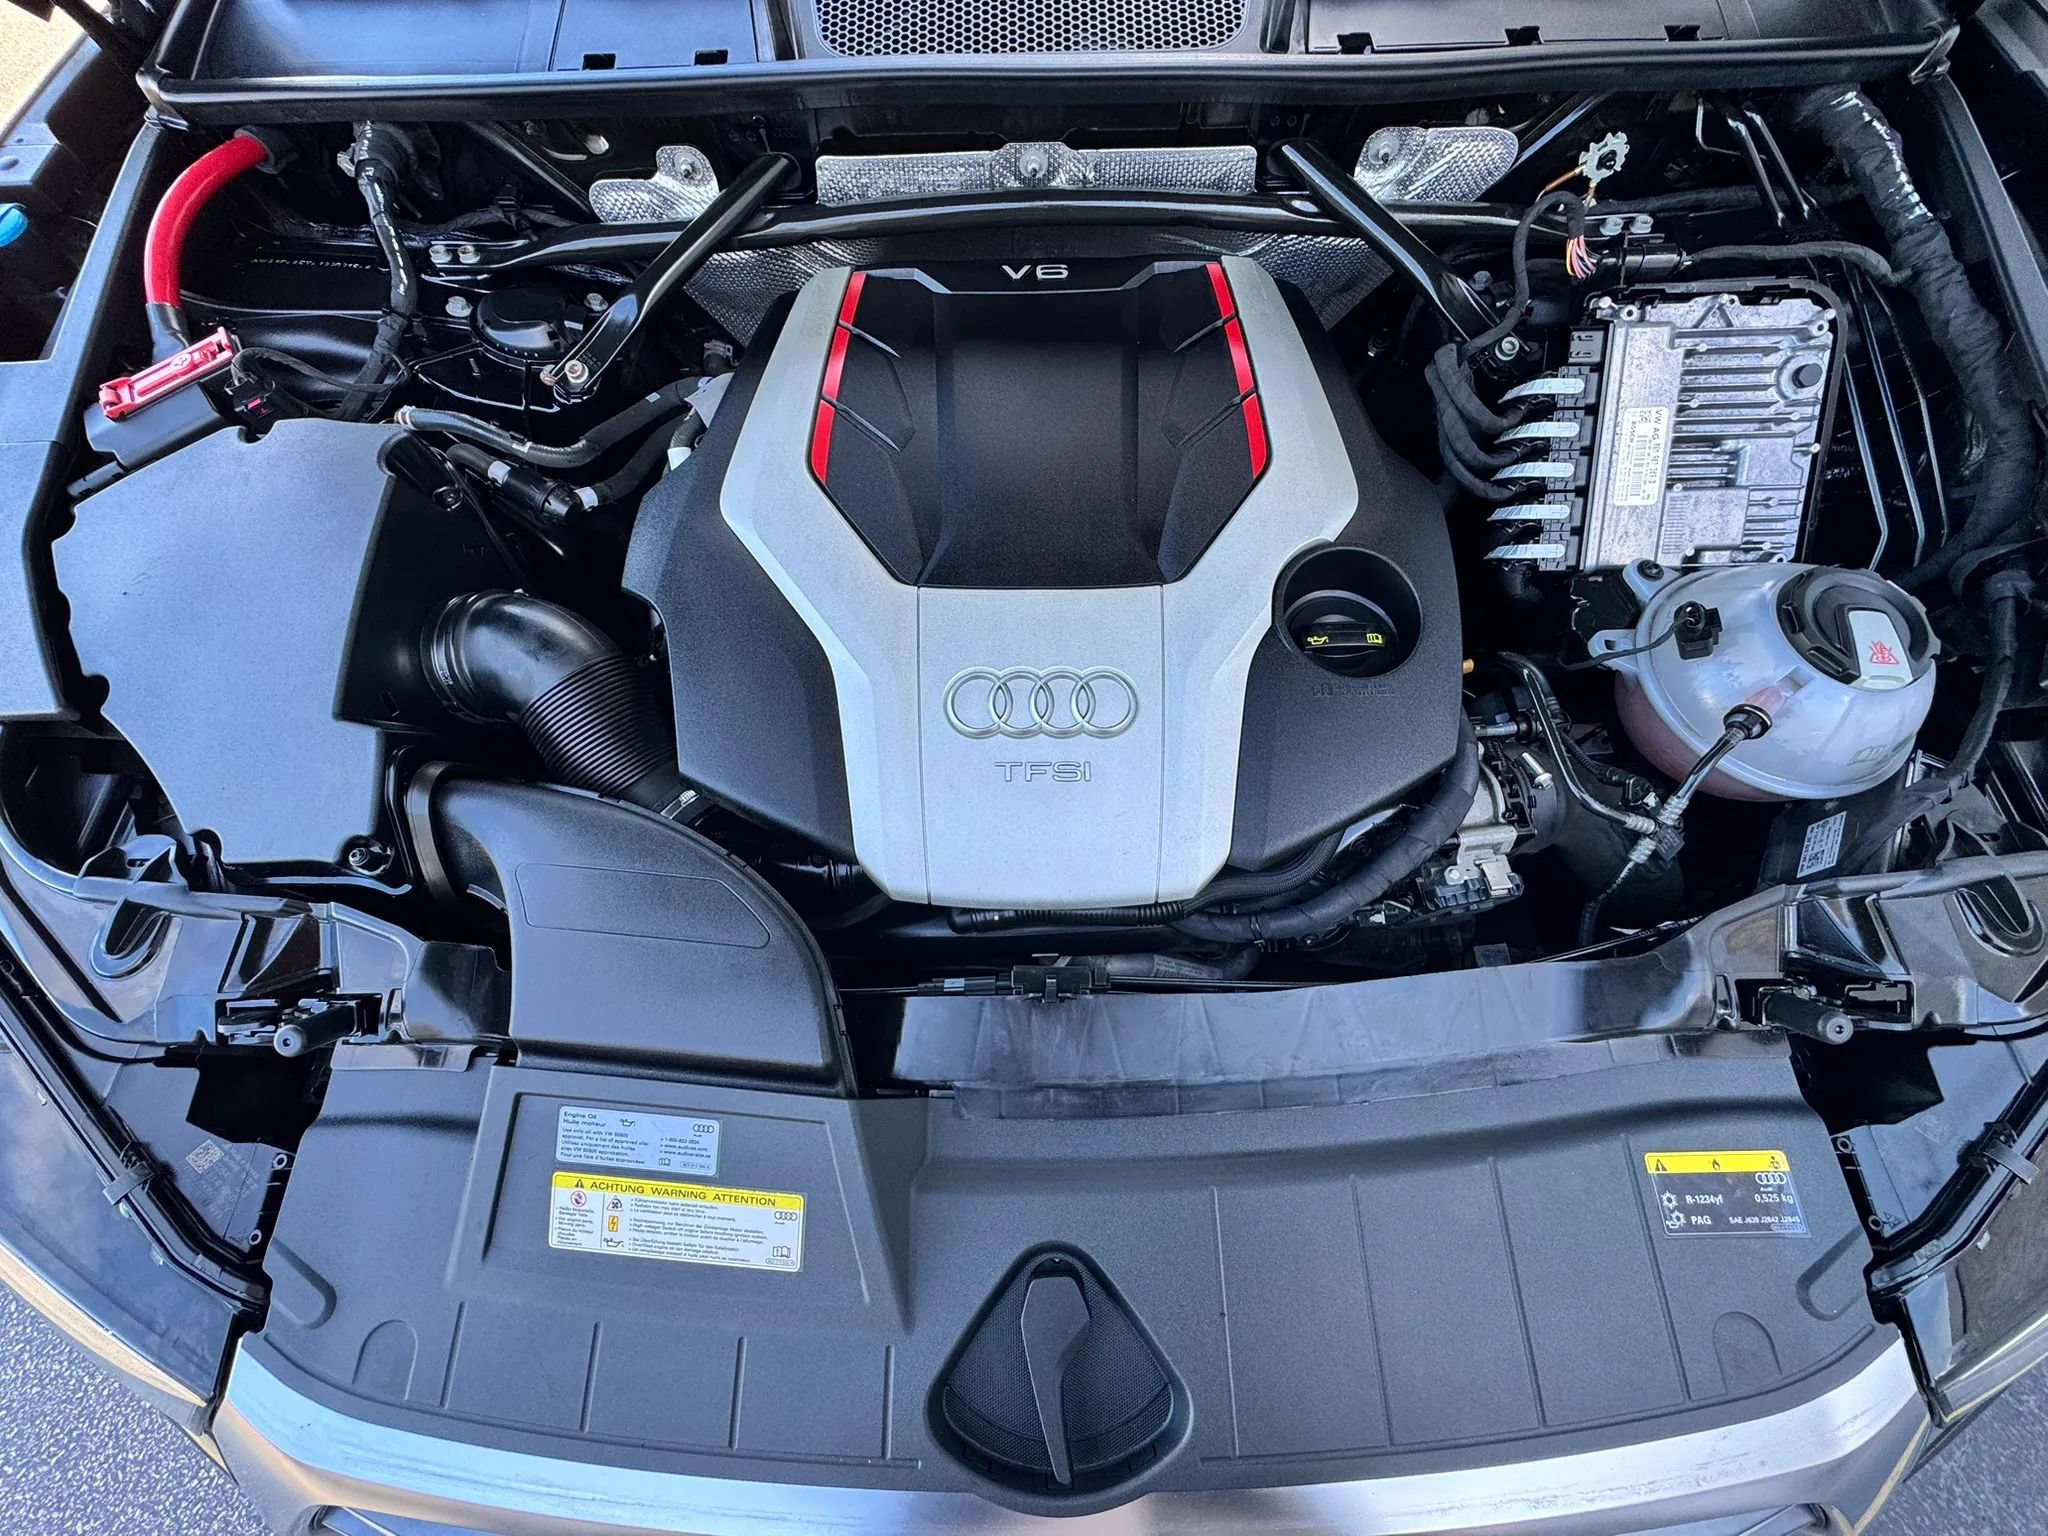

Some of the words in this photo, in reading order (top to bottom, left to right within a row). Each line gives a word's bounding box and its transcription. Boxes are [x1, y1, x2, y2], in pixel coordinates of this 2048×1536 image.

[1001, 264, 1068, 280] V6
[1654, 409, 1662, 425] VW
[1651, 427, 1660, 441] AG
[993, 761, 1092, 782] TFSI
[590, 1181, 644, 1194] ACHTUNG
[650, 1187, 706, 1200] WARNING
[712, 1193, 776, 1206] ATTENTION
[1685, 1193, 1724, 1206] R-1234yf
[1754, 1193, 1780, 1204] 0,525
[1780, 1193, 1794, 1204] kg
[1690, 1214, 1712, 1225] PAG
[1728, 1216, 1744, 1224] SAE
